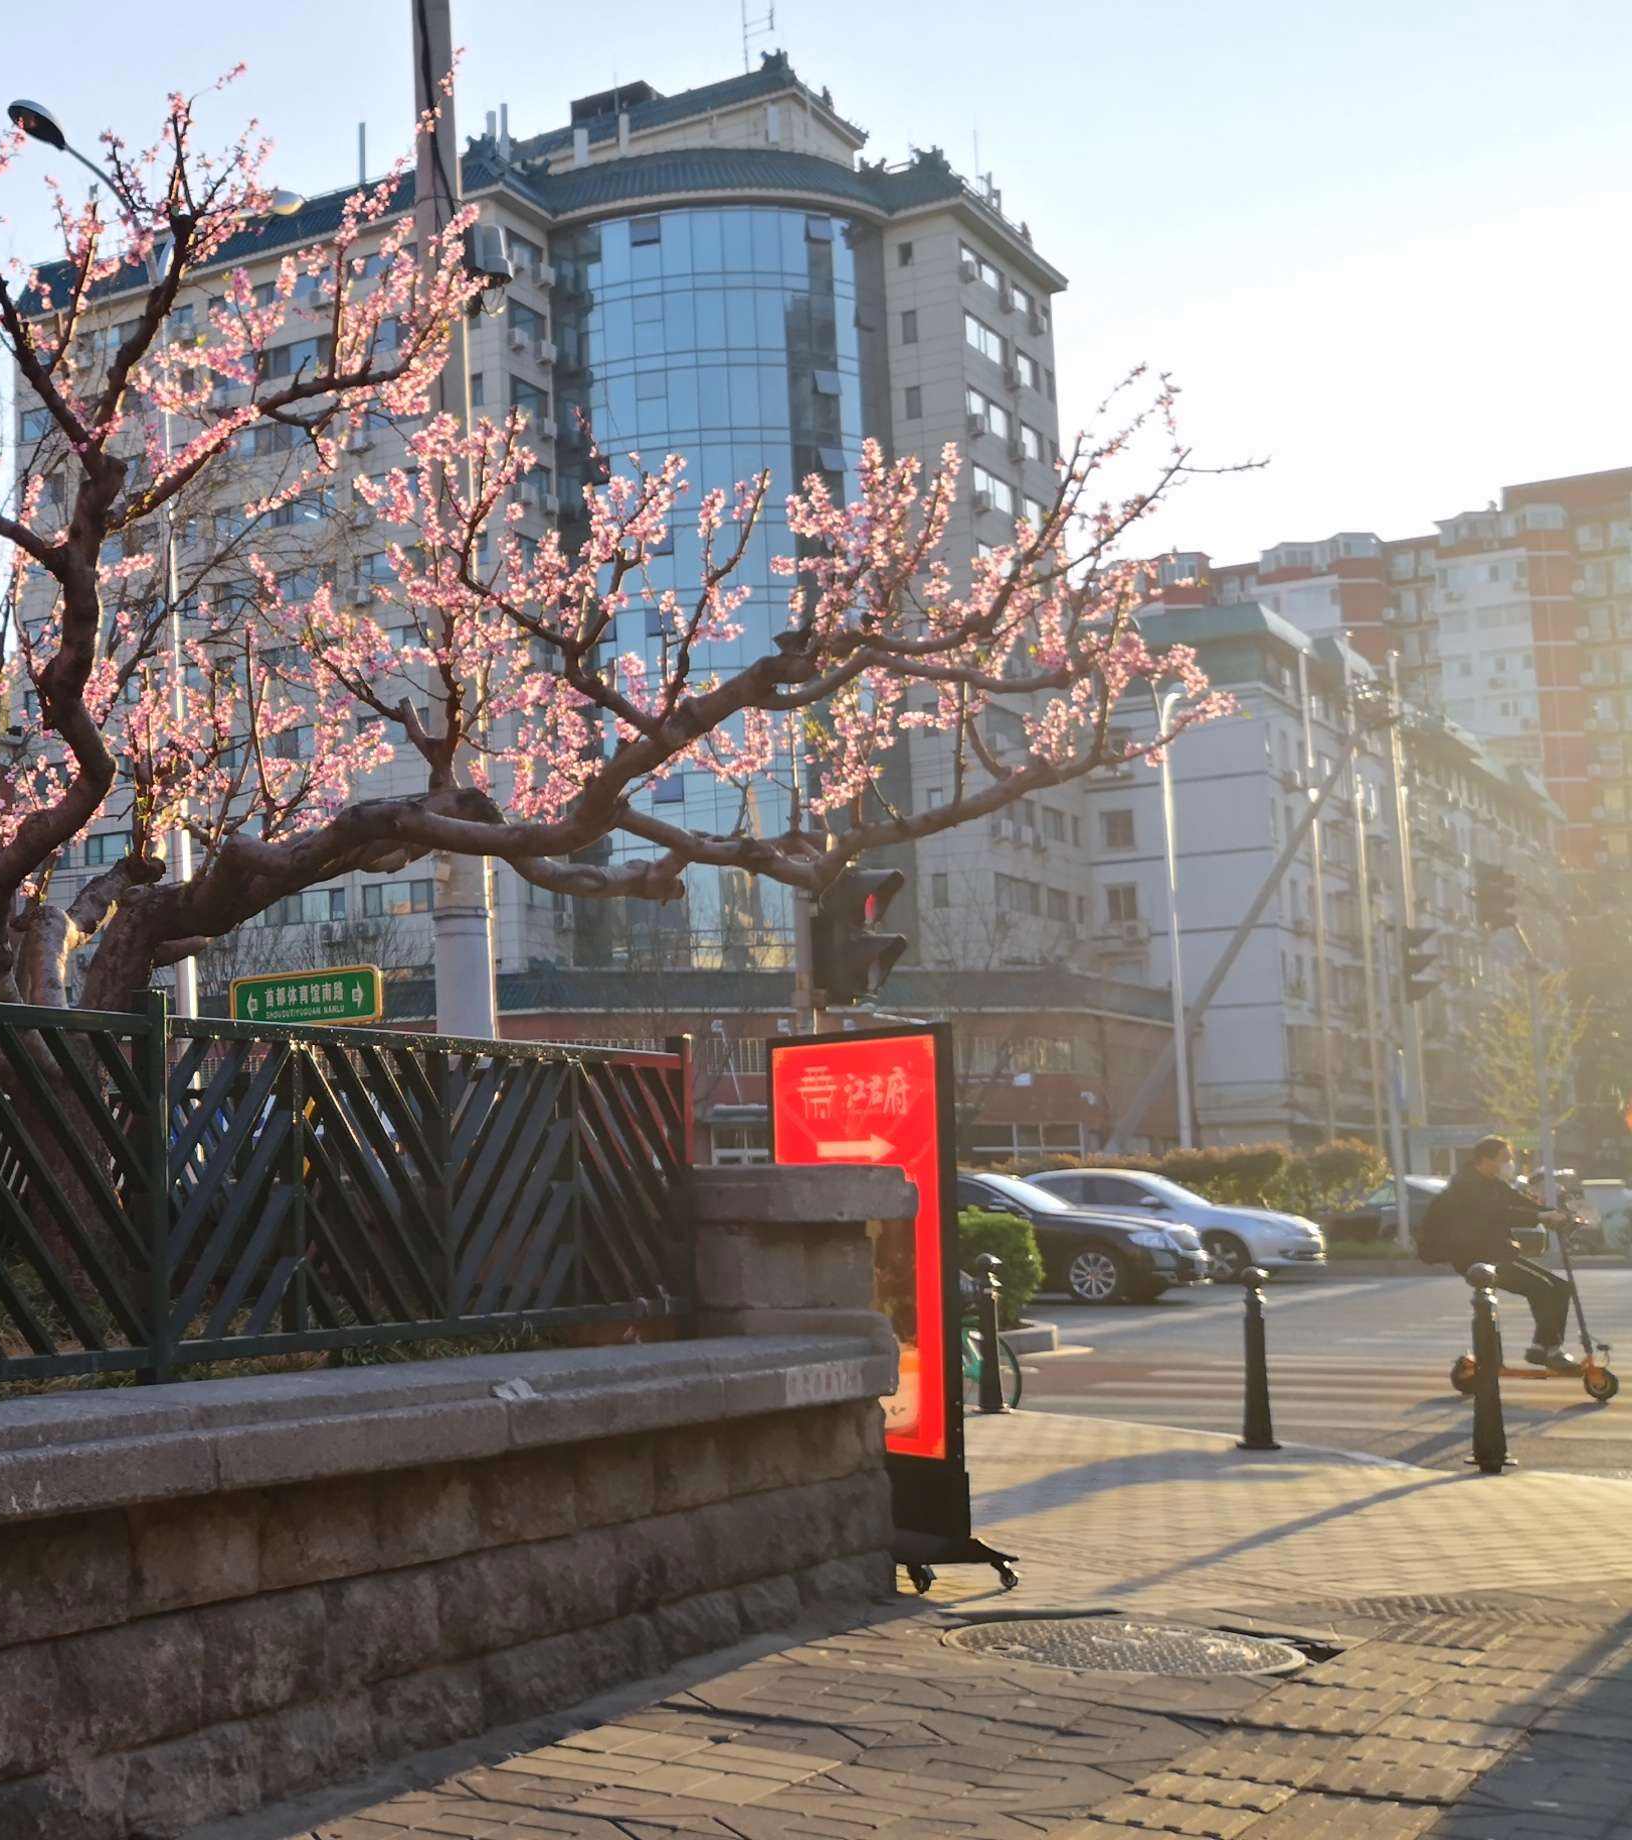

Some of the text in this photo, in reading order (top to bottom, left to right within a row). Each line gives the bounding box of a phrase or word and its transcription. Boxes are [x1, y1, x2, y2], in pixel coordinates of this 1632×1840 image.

[265, 982, 344, 1008] 首都体育馆南路
